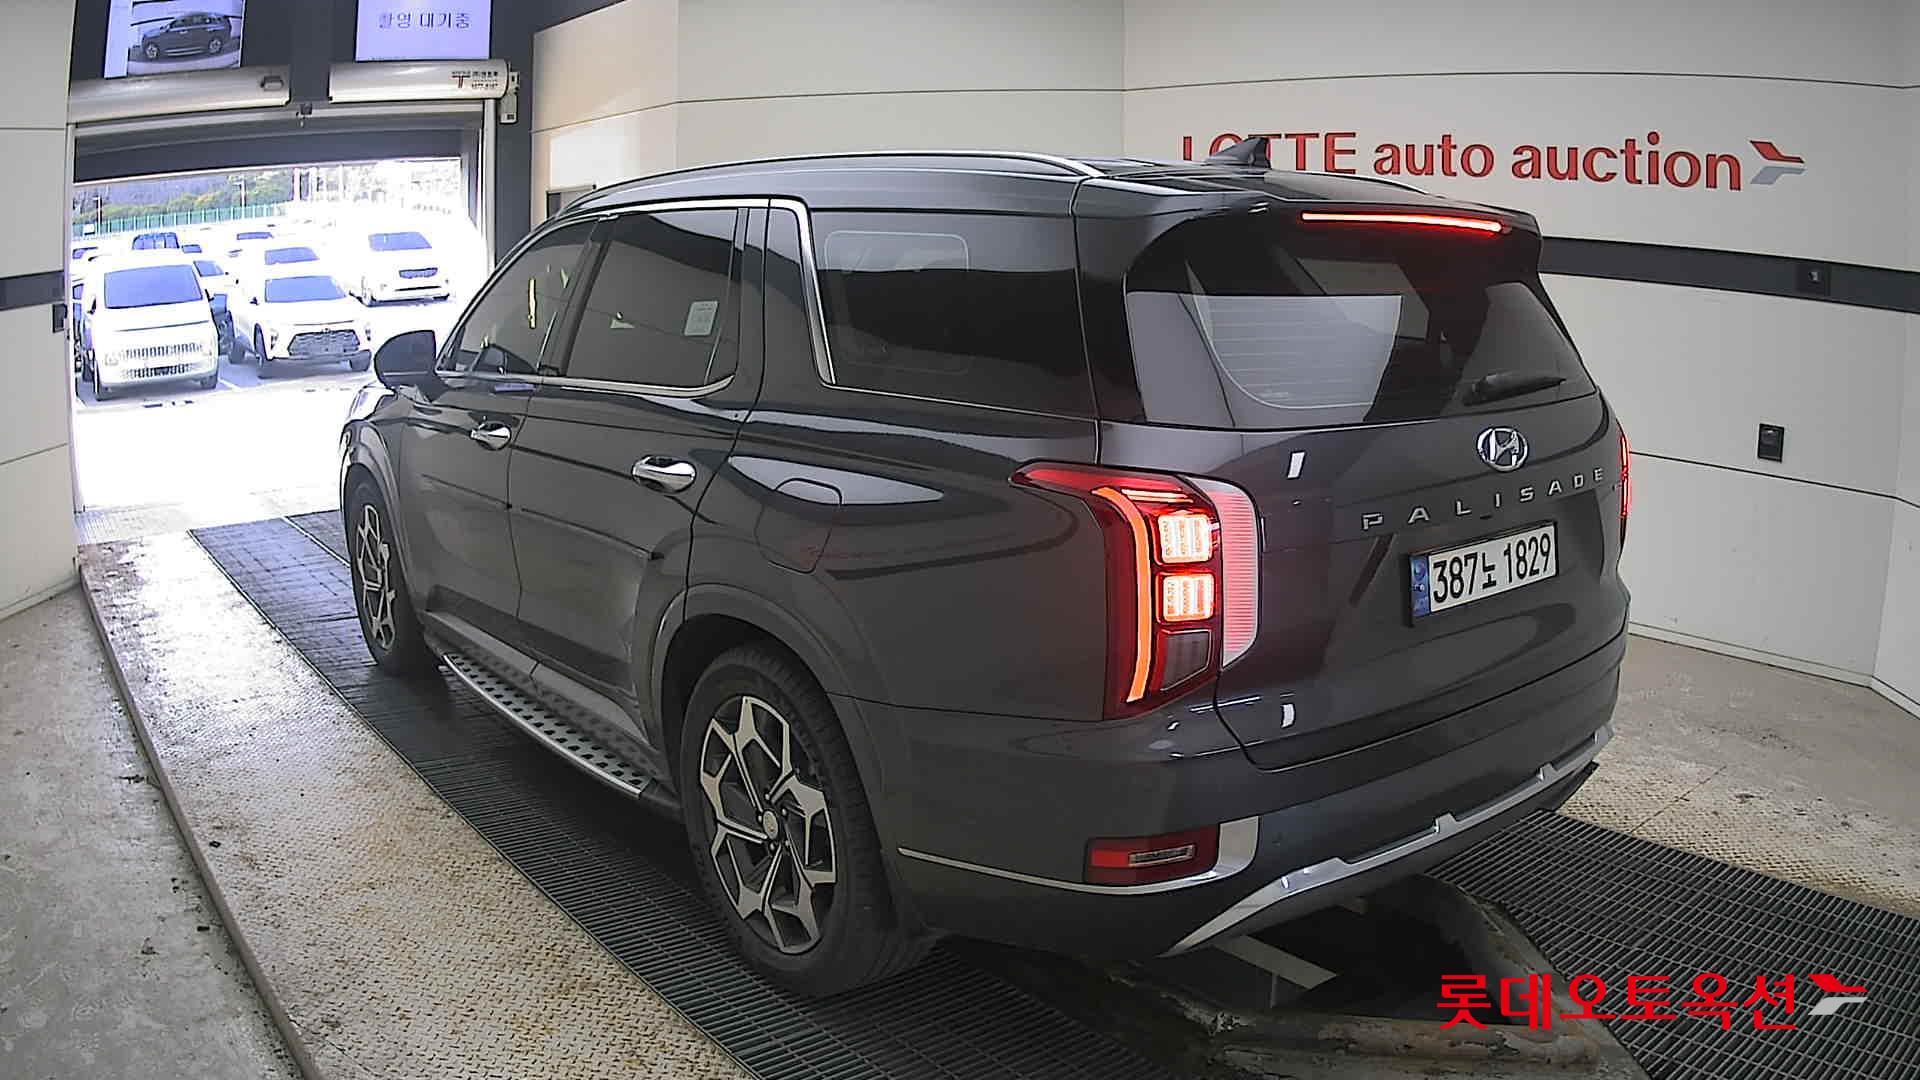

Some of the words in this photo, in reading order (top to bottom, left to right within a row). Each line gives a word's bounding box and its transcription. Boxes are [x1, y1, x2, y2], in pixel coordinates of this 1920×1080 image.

[419, 12, 470, 29] 대기중
[1374, 133, 1495, 177] auto
[1511, 131, 1744, 191] auction
[1362, 468, 1604, 530] PALISADE
[1433, 552, 1496, 603] 387노
[1503, 533, 1551, 583] 1829
